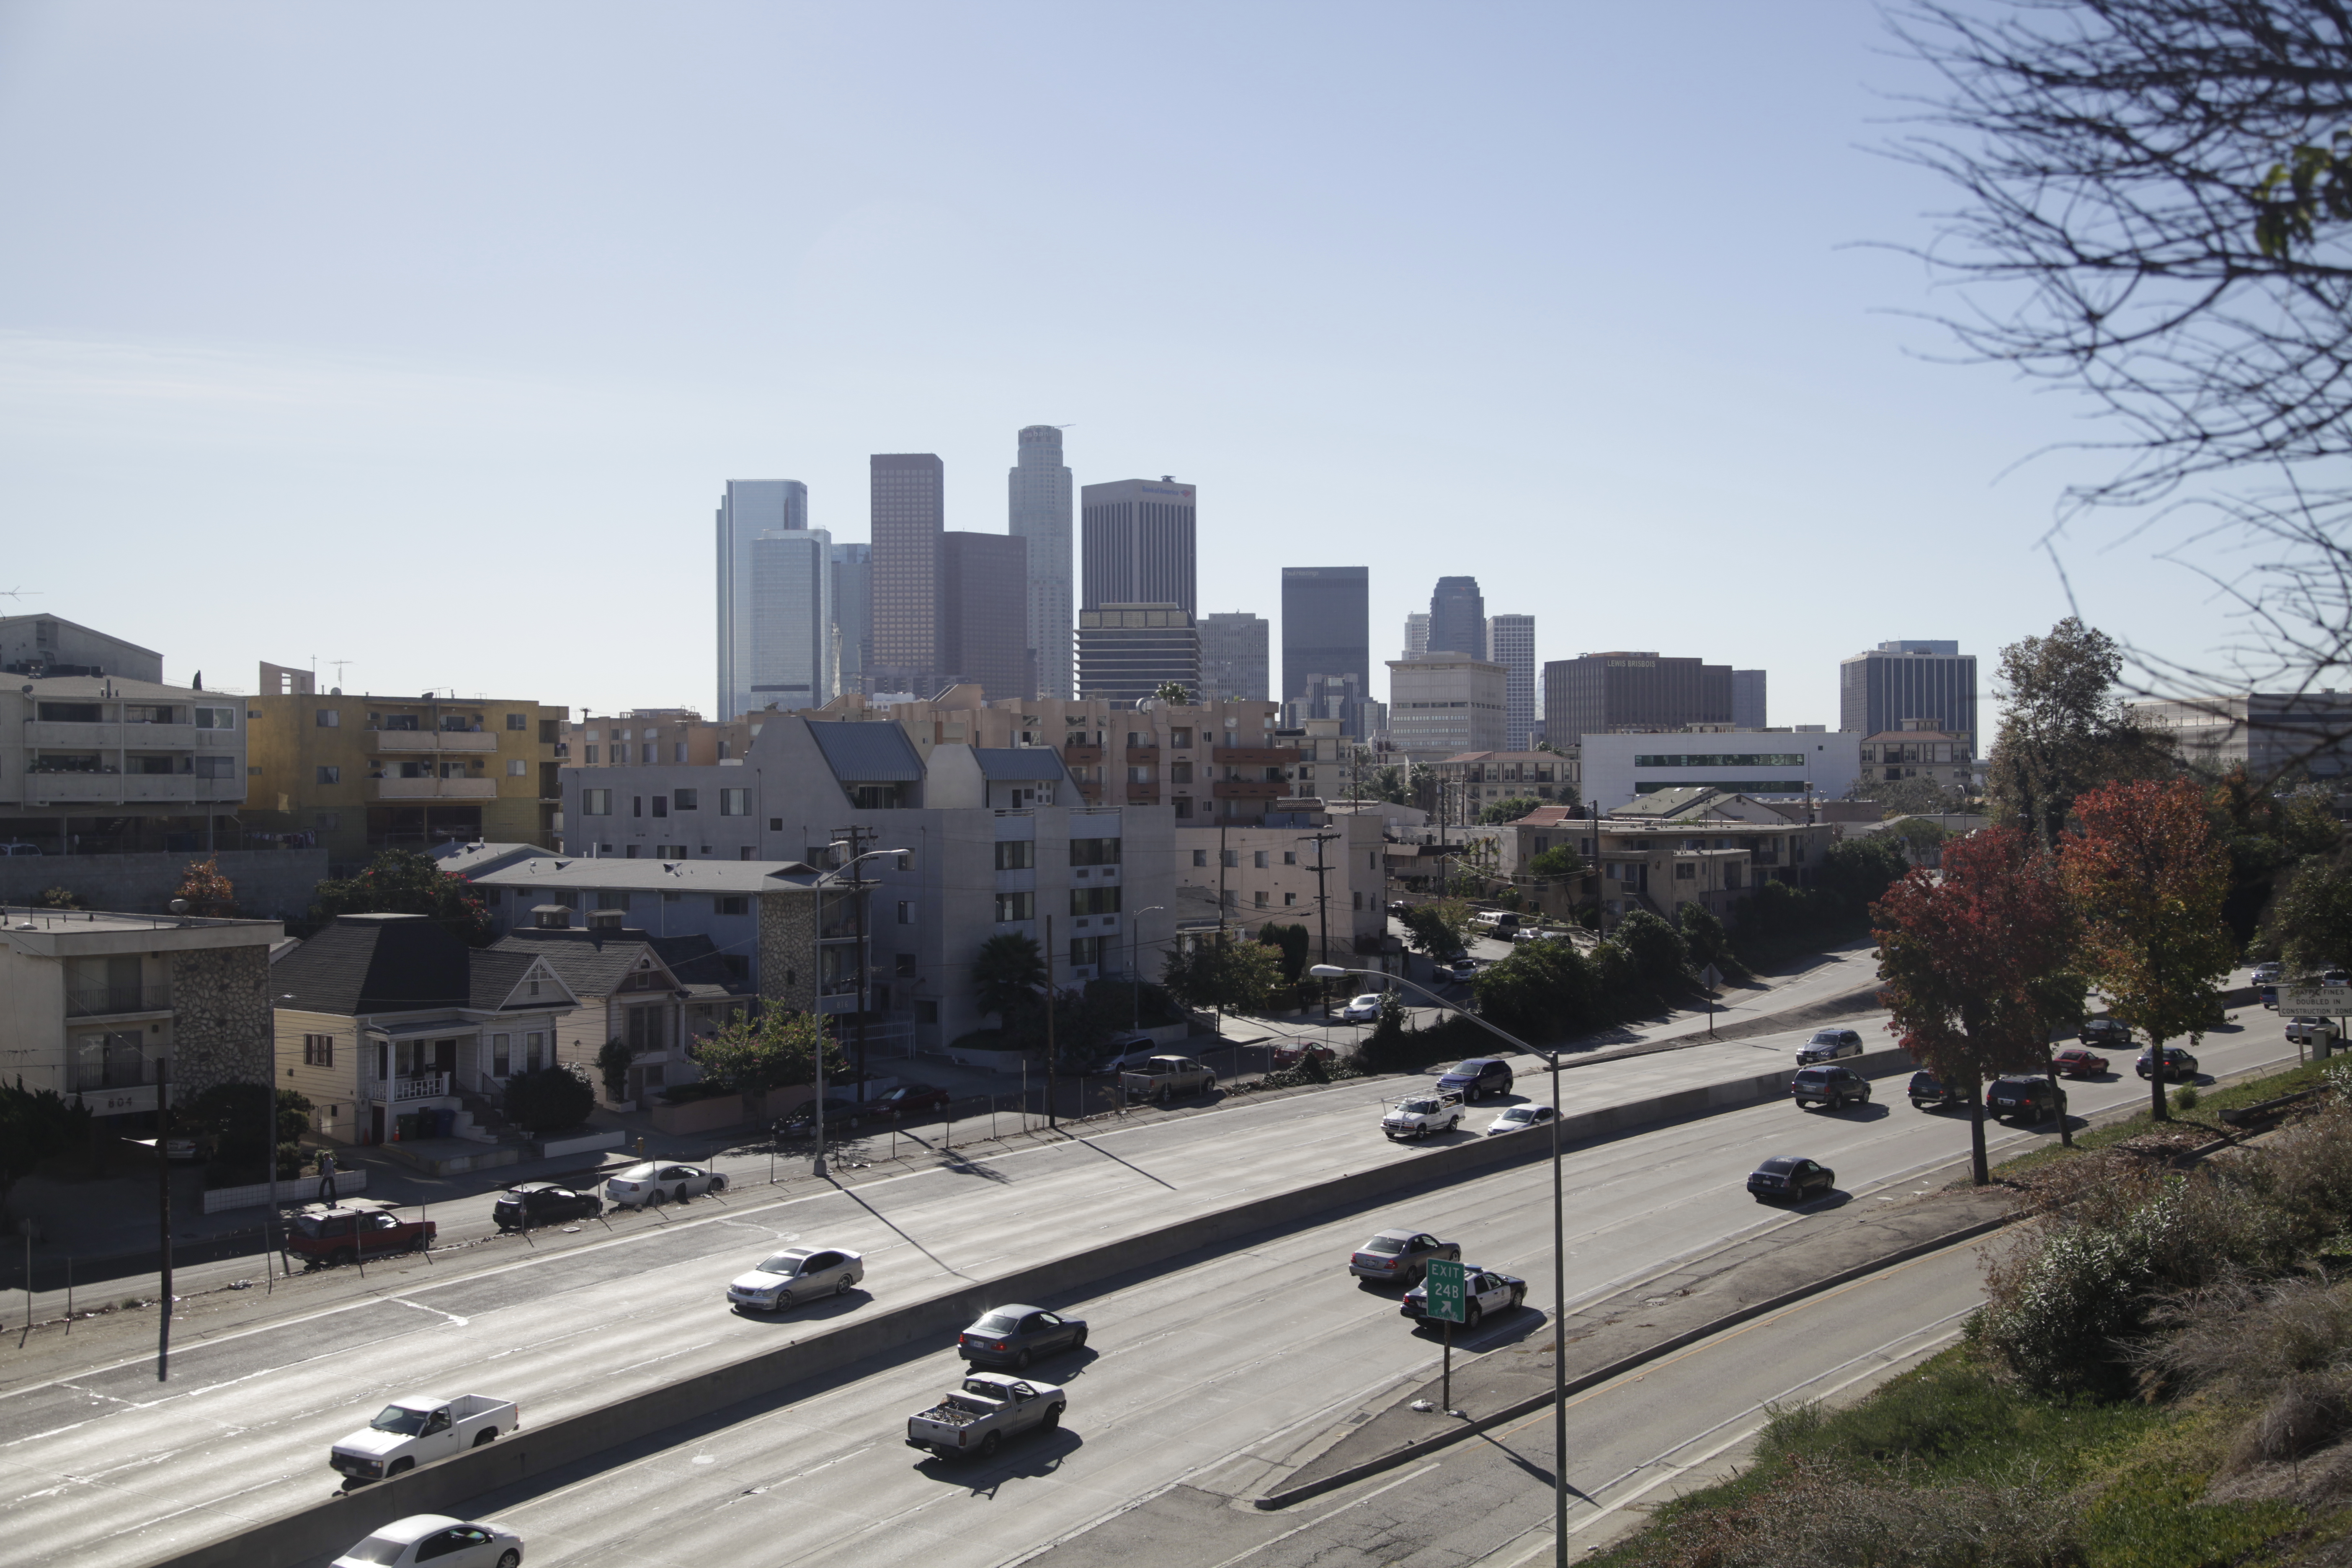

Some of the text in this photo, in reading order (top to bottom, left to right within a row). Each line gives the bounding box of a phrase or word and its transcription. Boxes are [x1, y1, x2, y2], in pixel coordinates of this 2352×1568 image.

[108, 1097, 132, 1108] 804
[1432, 1264, 1459, 1279] EXIT
[1435, 1282, 1458, 1298] 24B
